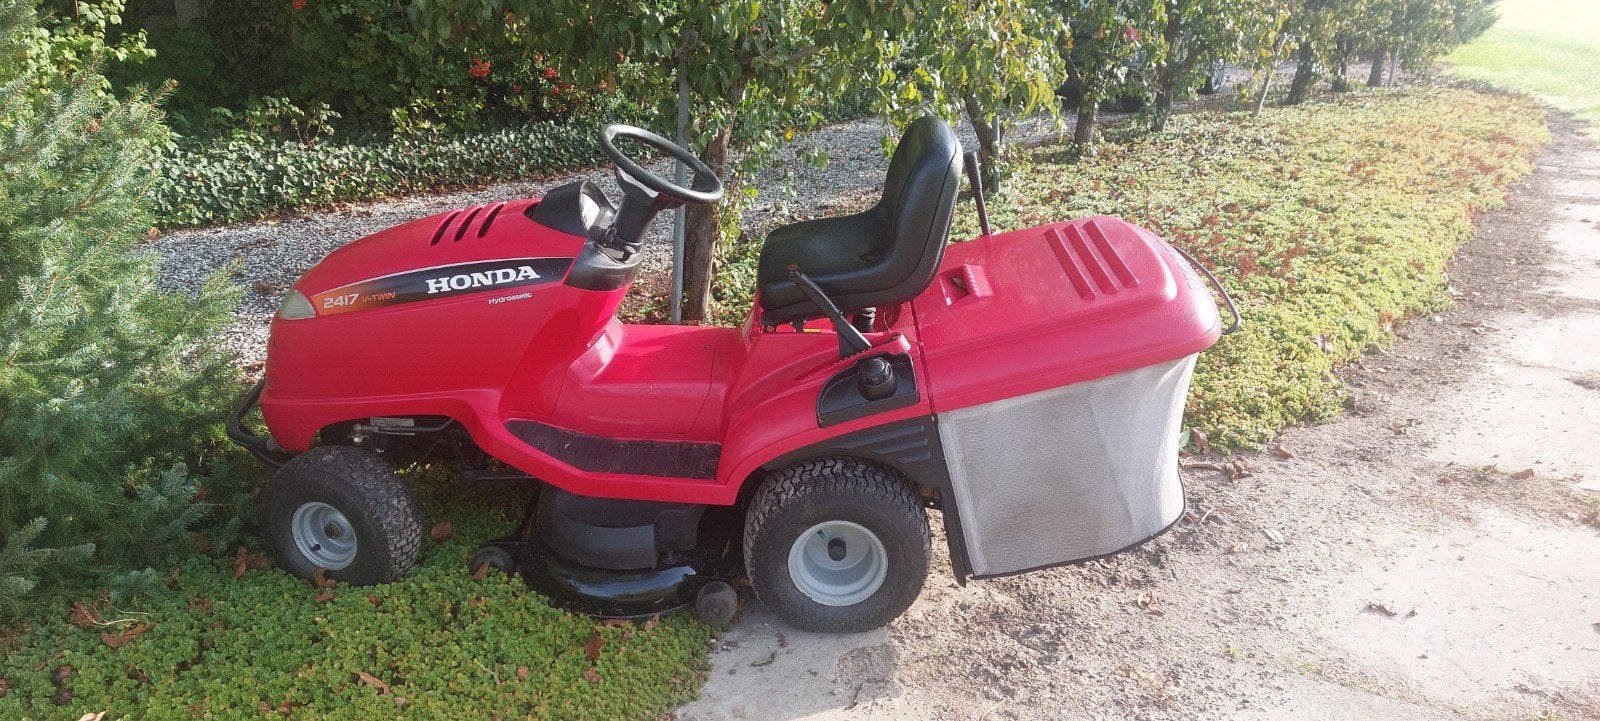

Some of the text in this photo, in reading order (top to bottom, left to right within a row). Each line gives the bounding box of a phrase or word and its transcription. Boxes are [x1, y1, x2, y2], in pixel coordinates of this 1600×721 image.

[425, 265, 541, 294] HONDA
[323, 291, 396, 309] 2417 V-TWIN
[488, 291, 533, 305] Hydrostatic
